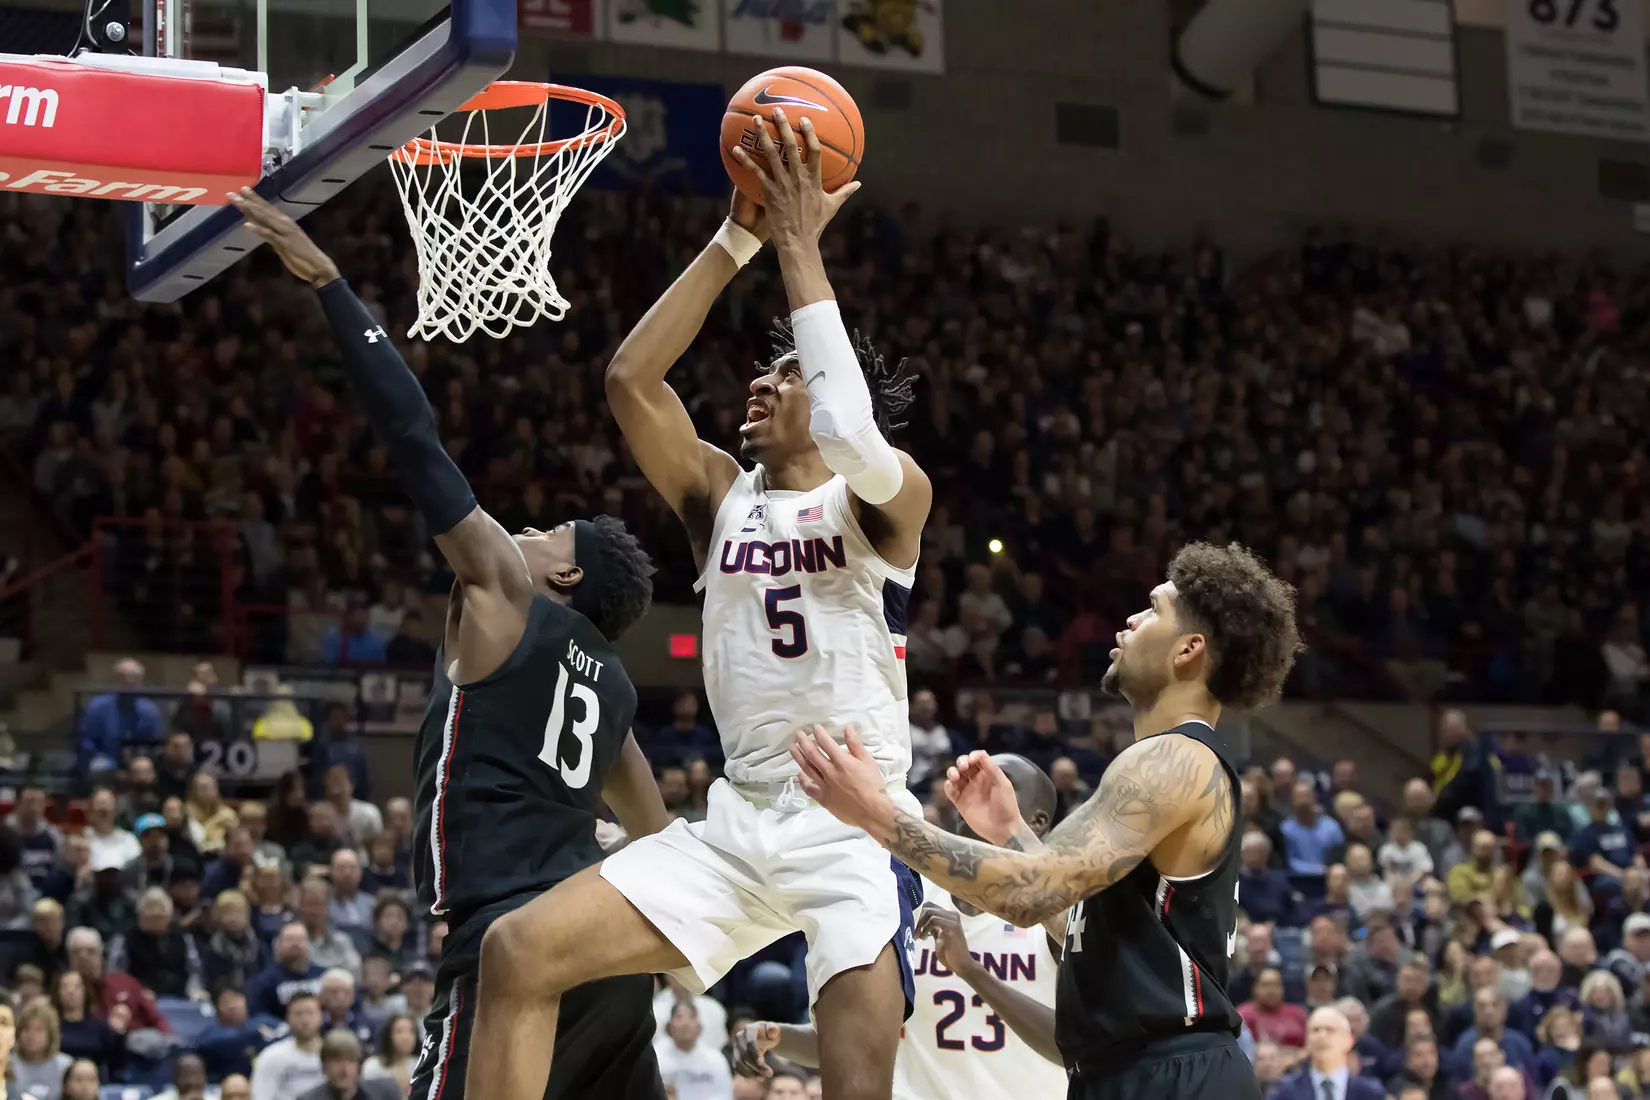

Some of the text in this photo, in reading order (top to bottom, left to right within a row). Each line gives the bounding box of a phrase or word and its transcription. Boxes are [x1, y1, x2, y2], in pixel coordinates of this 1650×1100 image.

[5, 169, 208, 201] Farm
[720, 535, 847, 577] UCONN
[764, 584, 808, 659] 5
[566, 638, 604, 683] SCOTT
[537, 660, 600, 789] 13
[933, 989, 1005, 1053] 23
